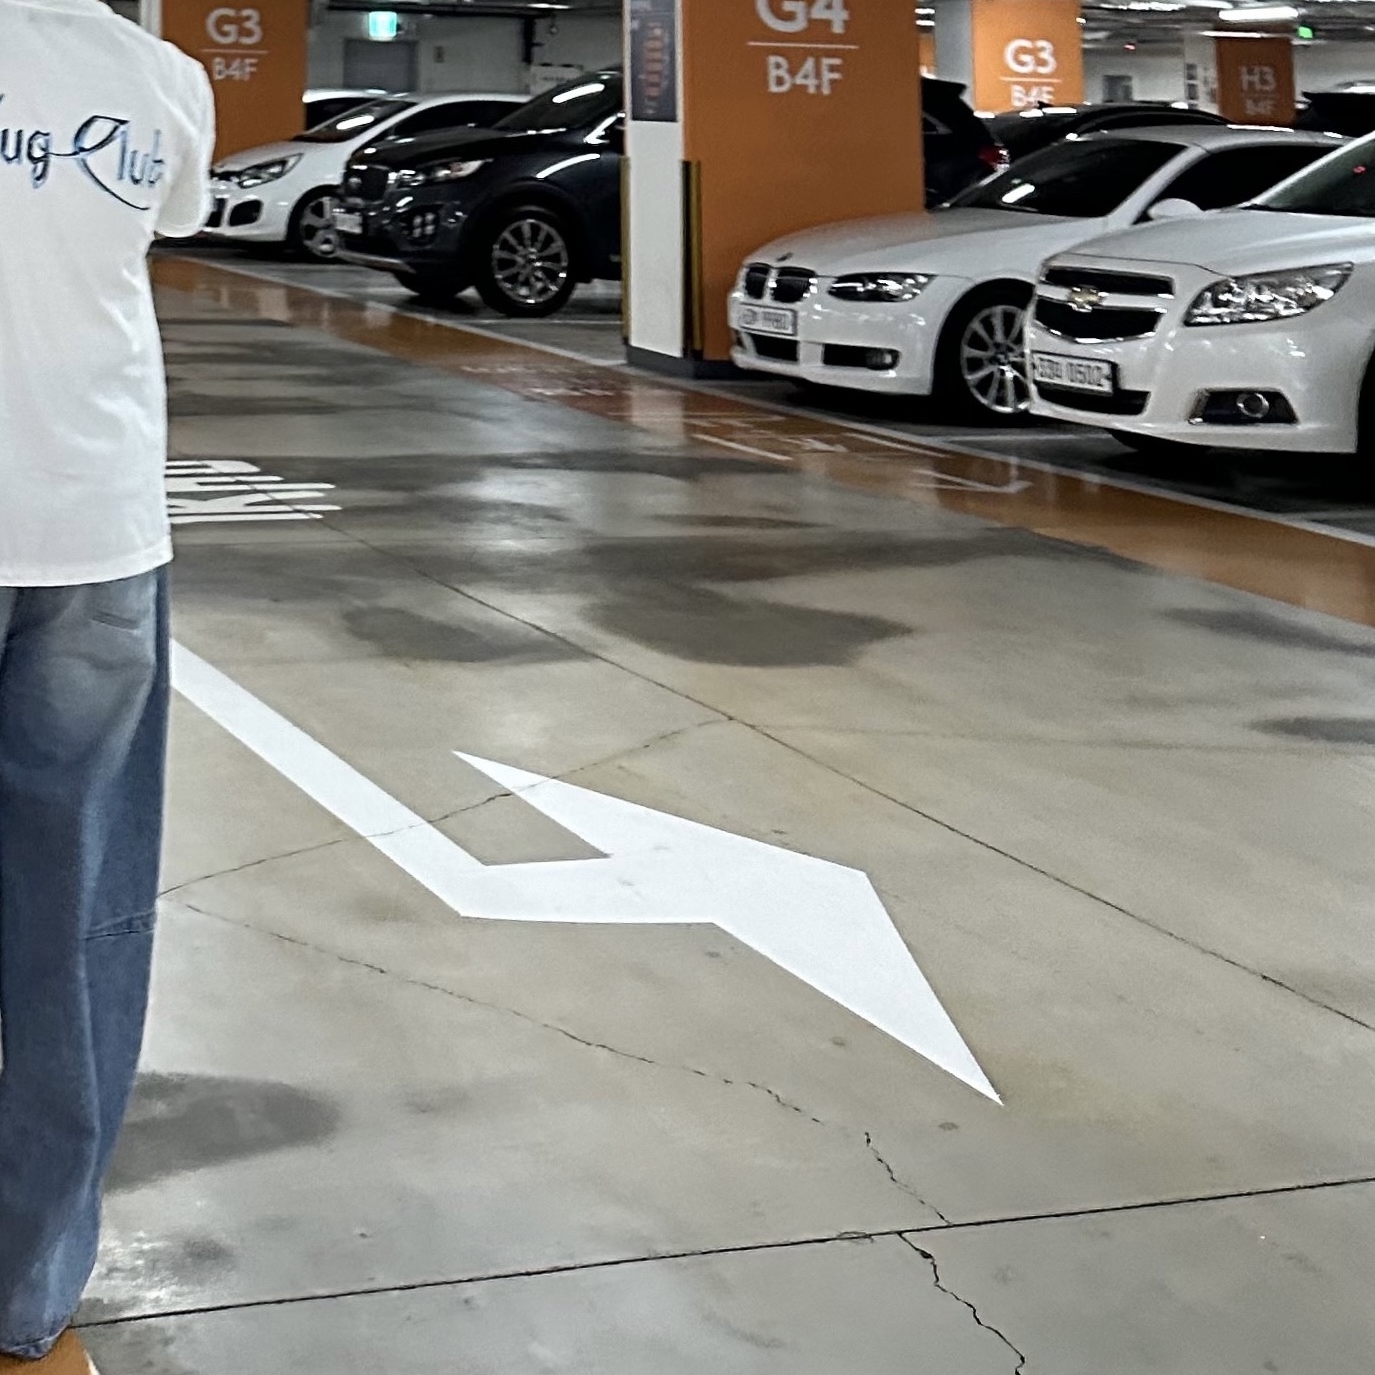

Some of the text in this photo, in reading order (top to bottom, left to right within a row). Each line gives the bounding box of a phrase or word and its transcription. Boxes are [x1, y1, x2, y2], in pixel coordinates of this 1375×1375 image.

[205, 7, 263, 44] G3
[212, 57, 259, 81] B4F
[767, 54, 843, 95] B4F
[1004, 38, 1057, 74] G3
[73, 114, 165, 210] Club
